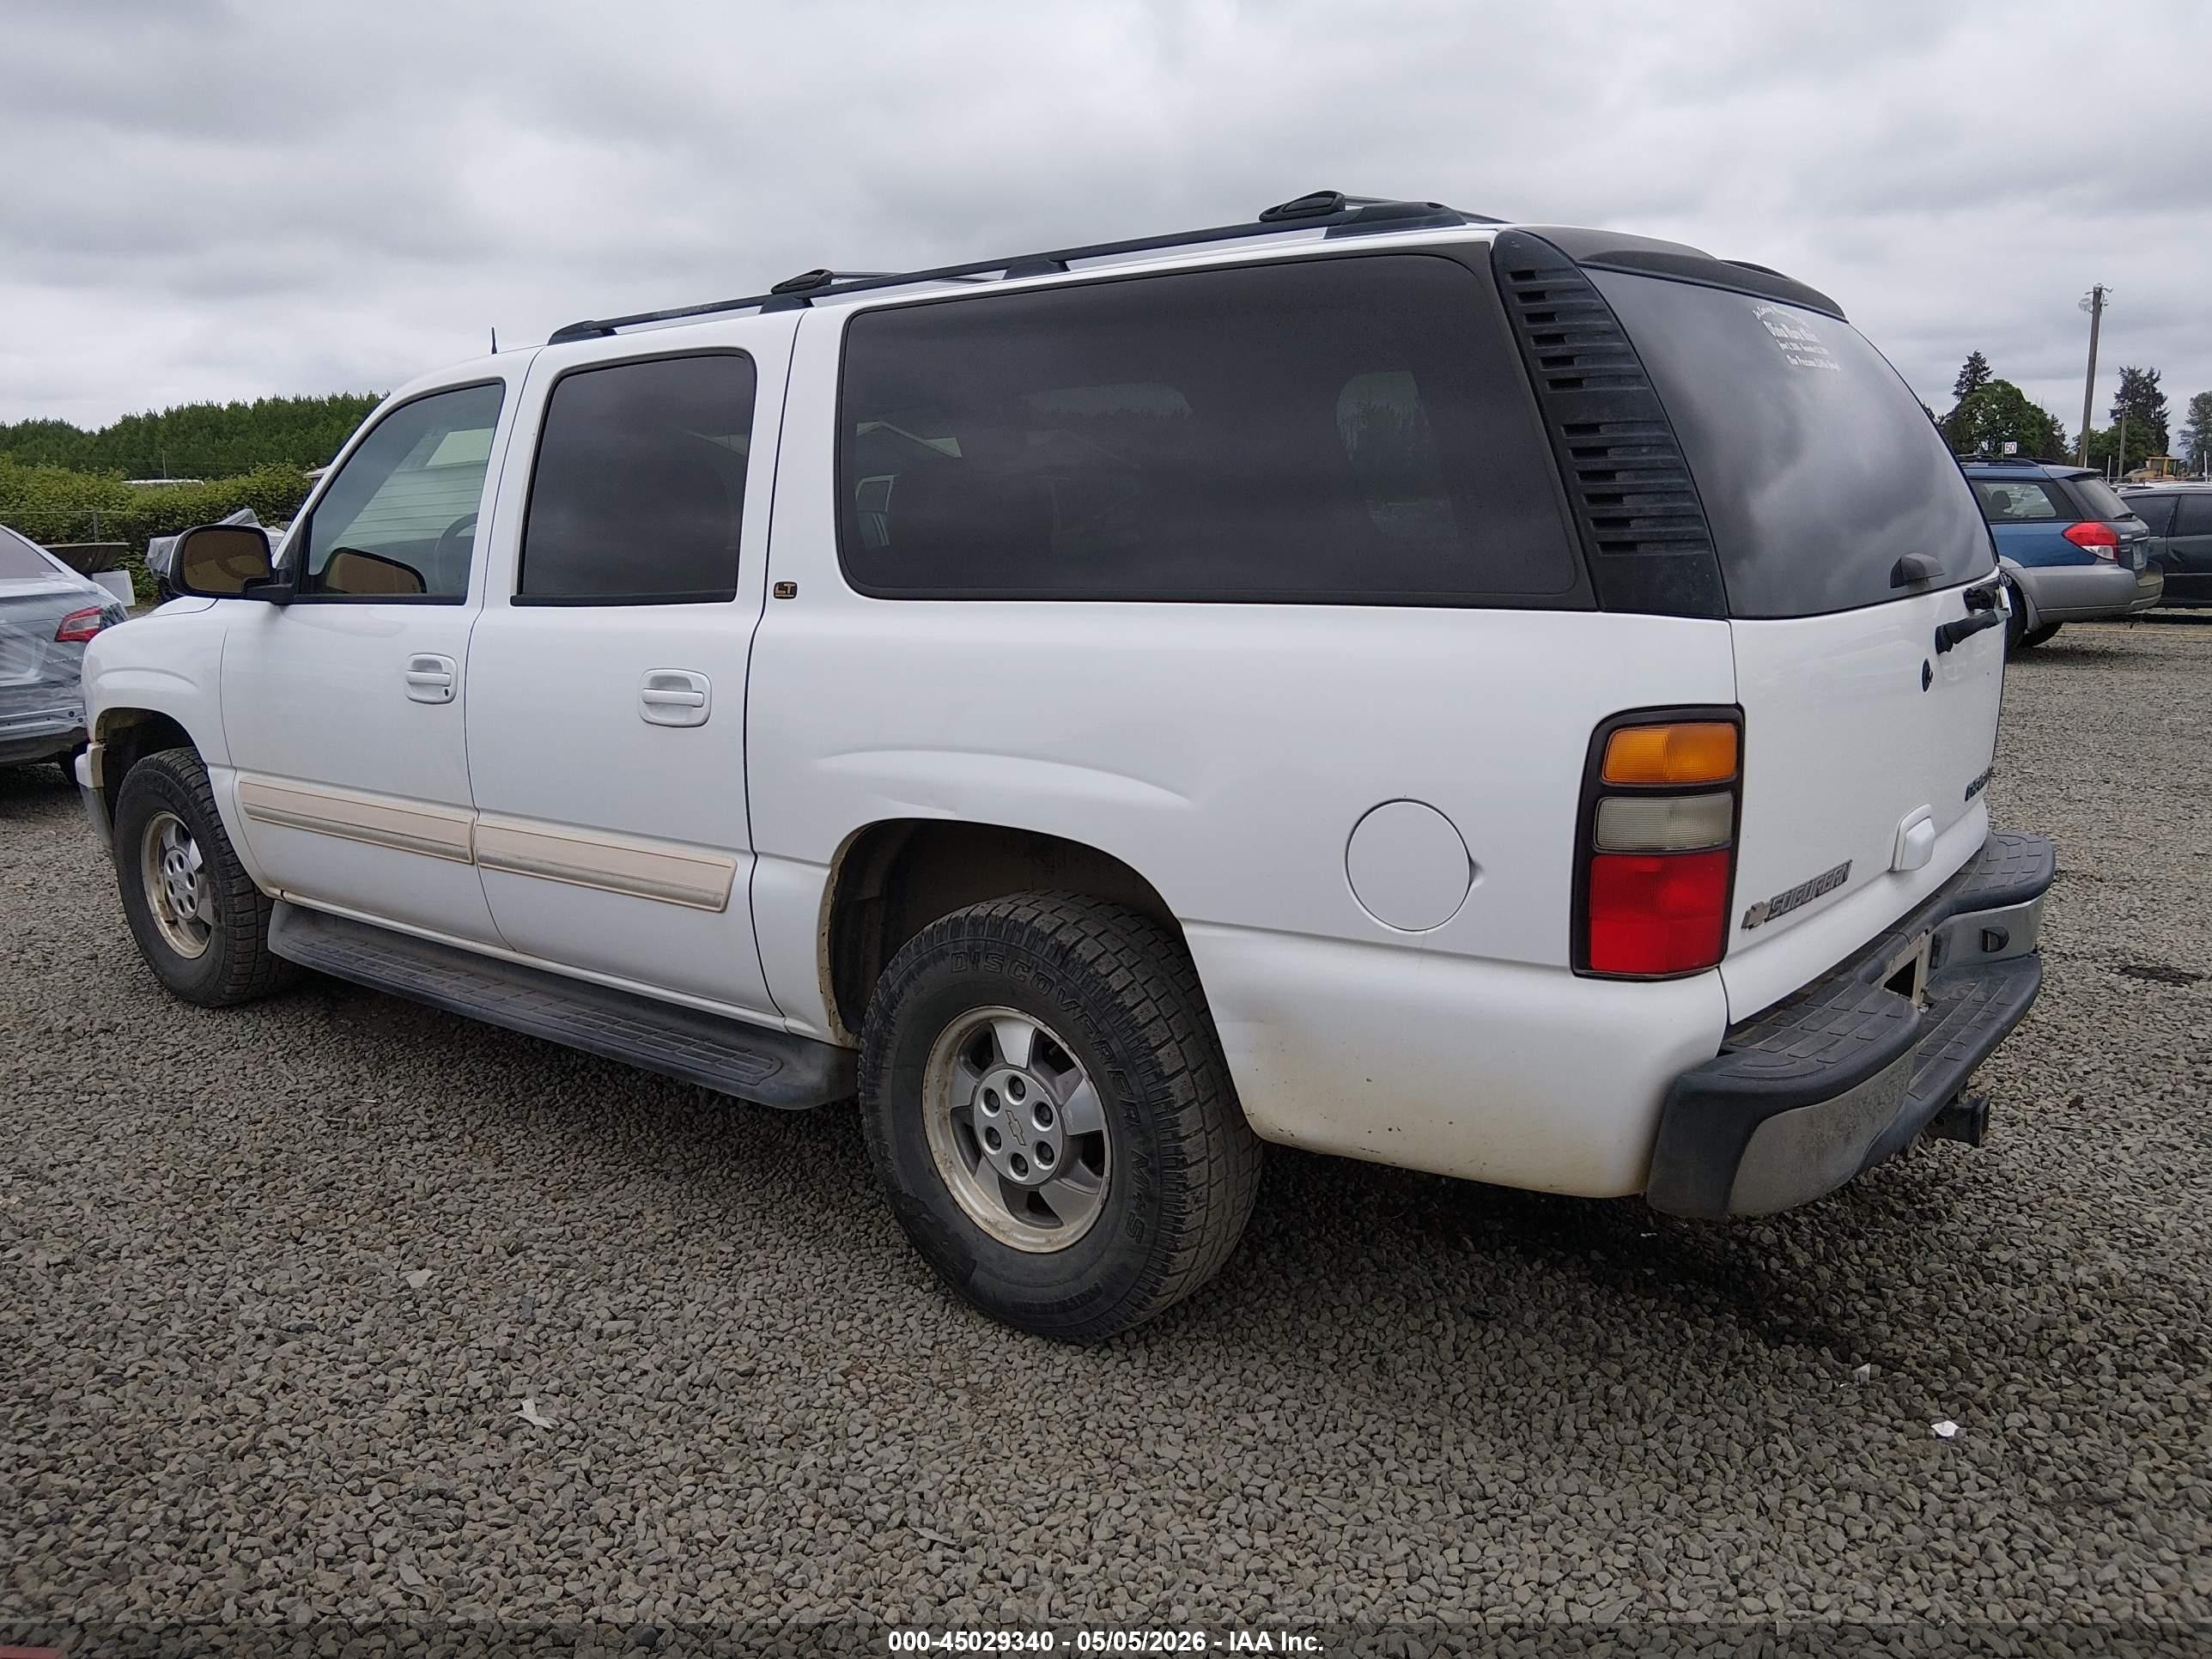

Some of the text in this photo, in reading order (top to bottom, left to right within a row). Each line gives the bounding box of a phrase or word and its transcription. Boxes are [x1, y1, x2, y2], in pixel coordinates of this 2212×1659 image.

[2006, 443, 2016, 453] 50
[775, 583, 796, 594] LT
[1765, 859, 1852, 922] SUBURBAN
[950, 950, 1142, 1127] DISCOVERER
